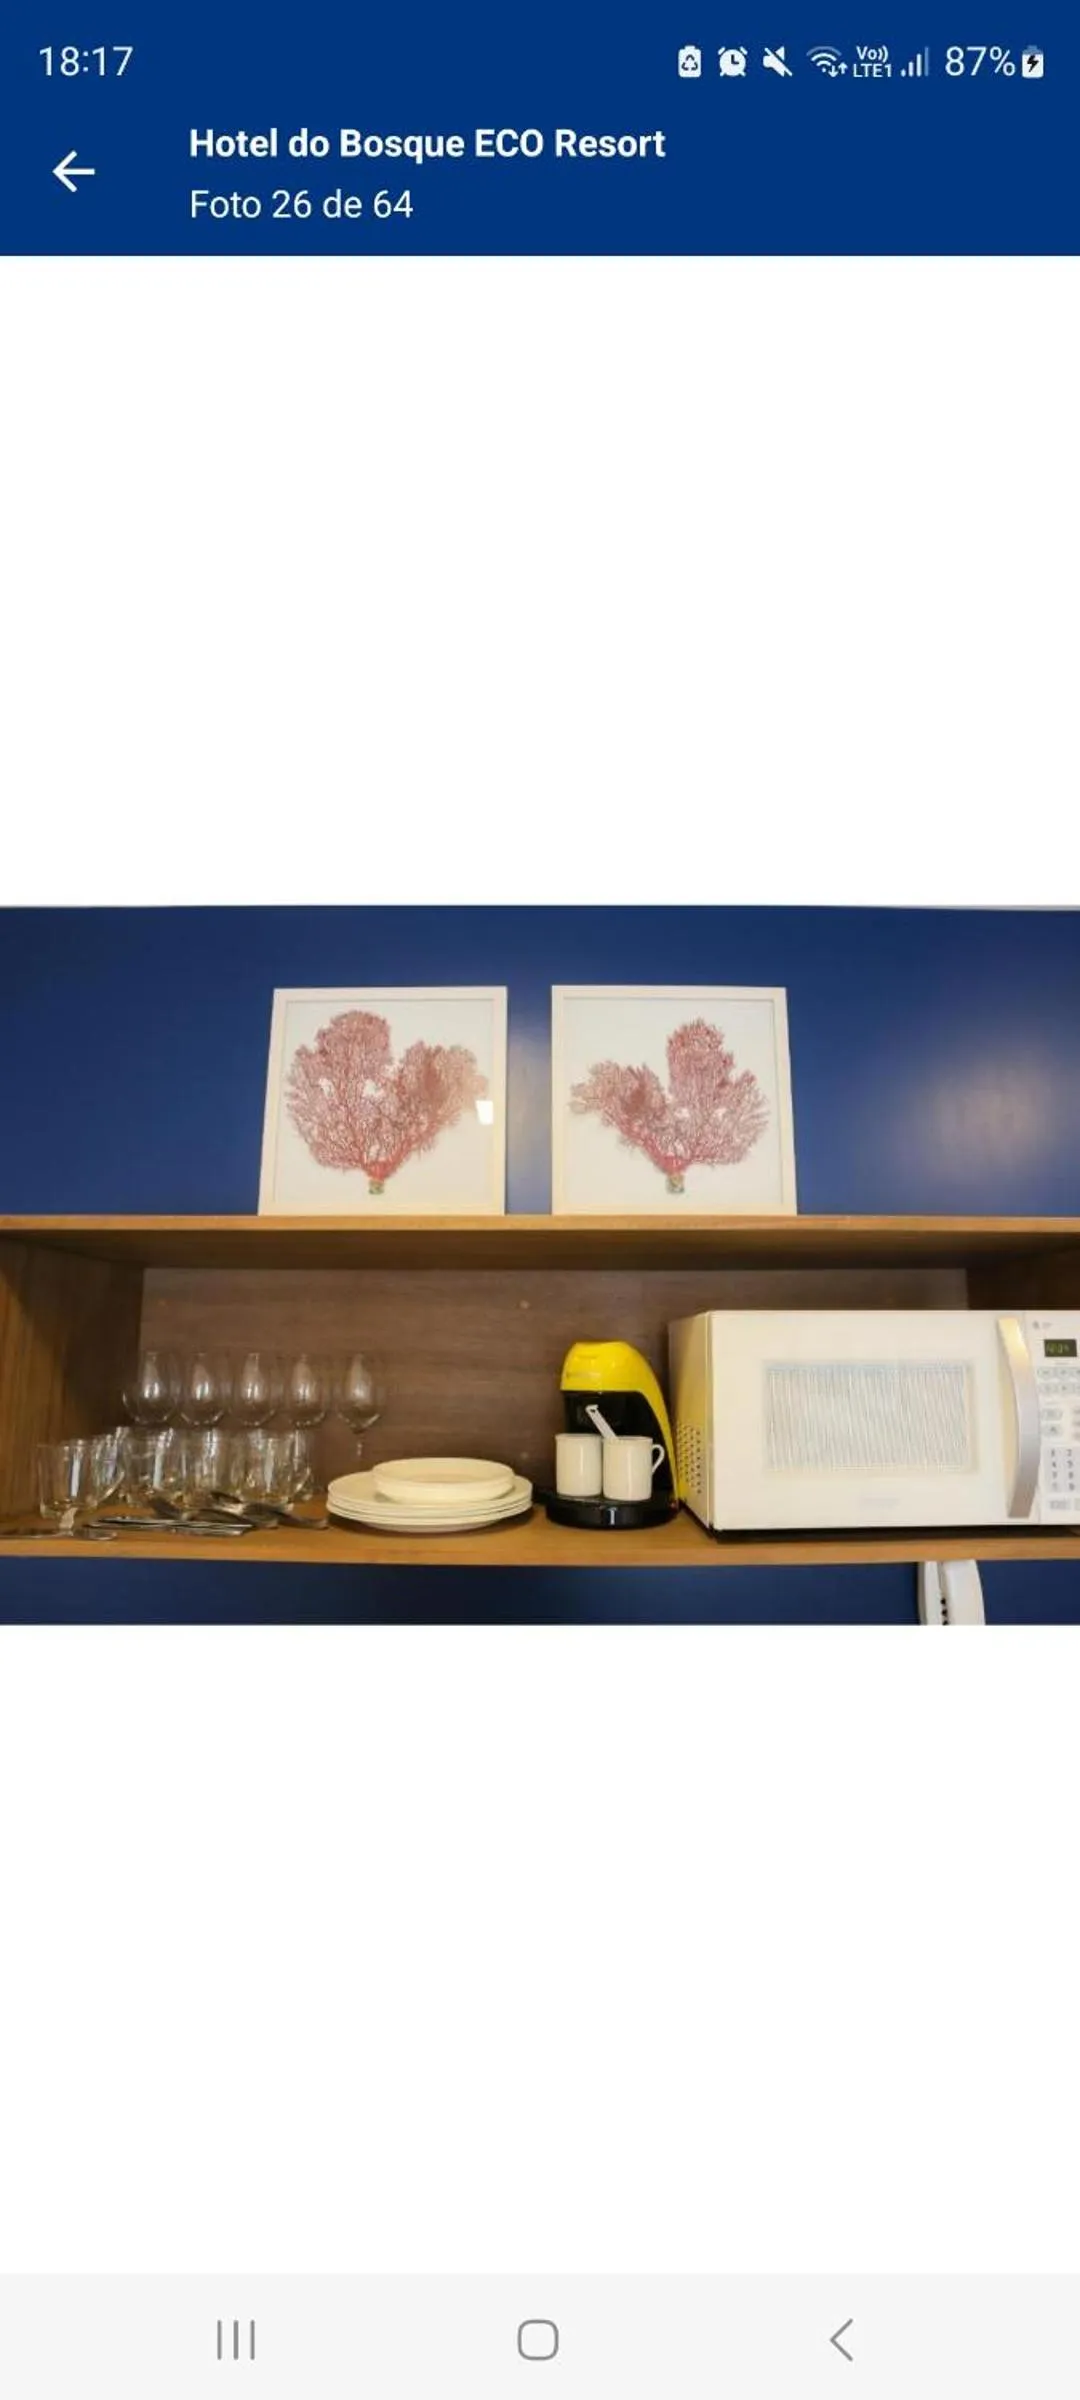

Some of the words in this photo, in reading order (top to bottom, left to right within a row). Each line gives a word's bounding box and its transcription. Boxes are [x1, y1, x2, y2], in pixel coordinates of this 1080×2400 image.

[40, 46, 134, 77] 18:17
[853, 63, 892, 78] LTE1
[945, 45, 1016, 77] 87%
[190, 128, 278, 158] Hotel
[288, 128, 330, 158] do
[340, 128, 465, 165] Bosque
[475, 128, 544, 158] ECO
[555, 128, 666, 158] Resort
[191, 189, 262, 219] Foto
[271, 189, 312, 219] 26
[322, 188, 363, 219] de
[373, 189, 414, 219] 64
